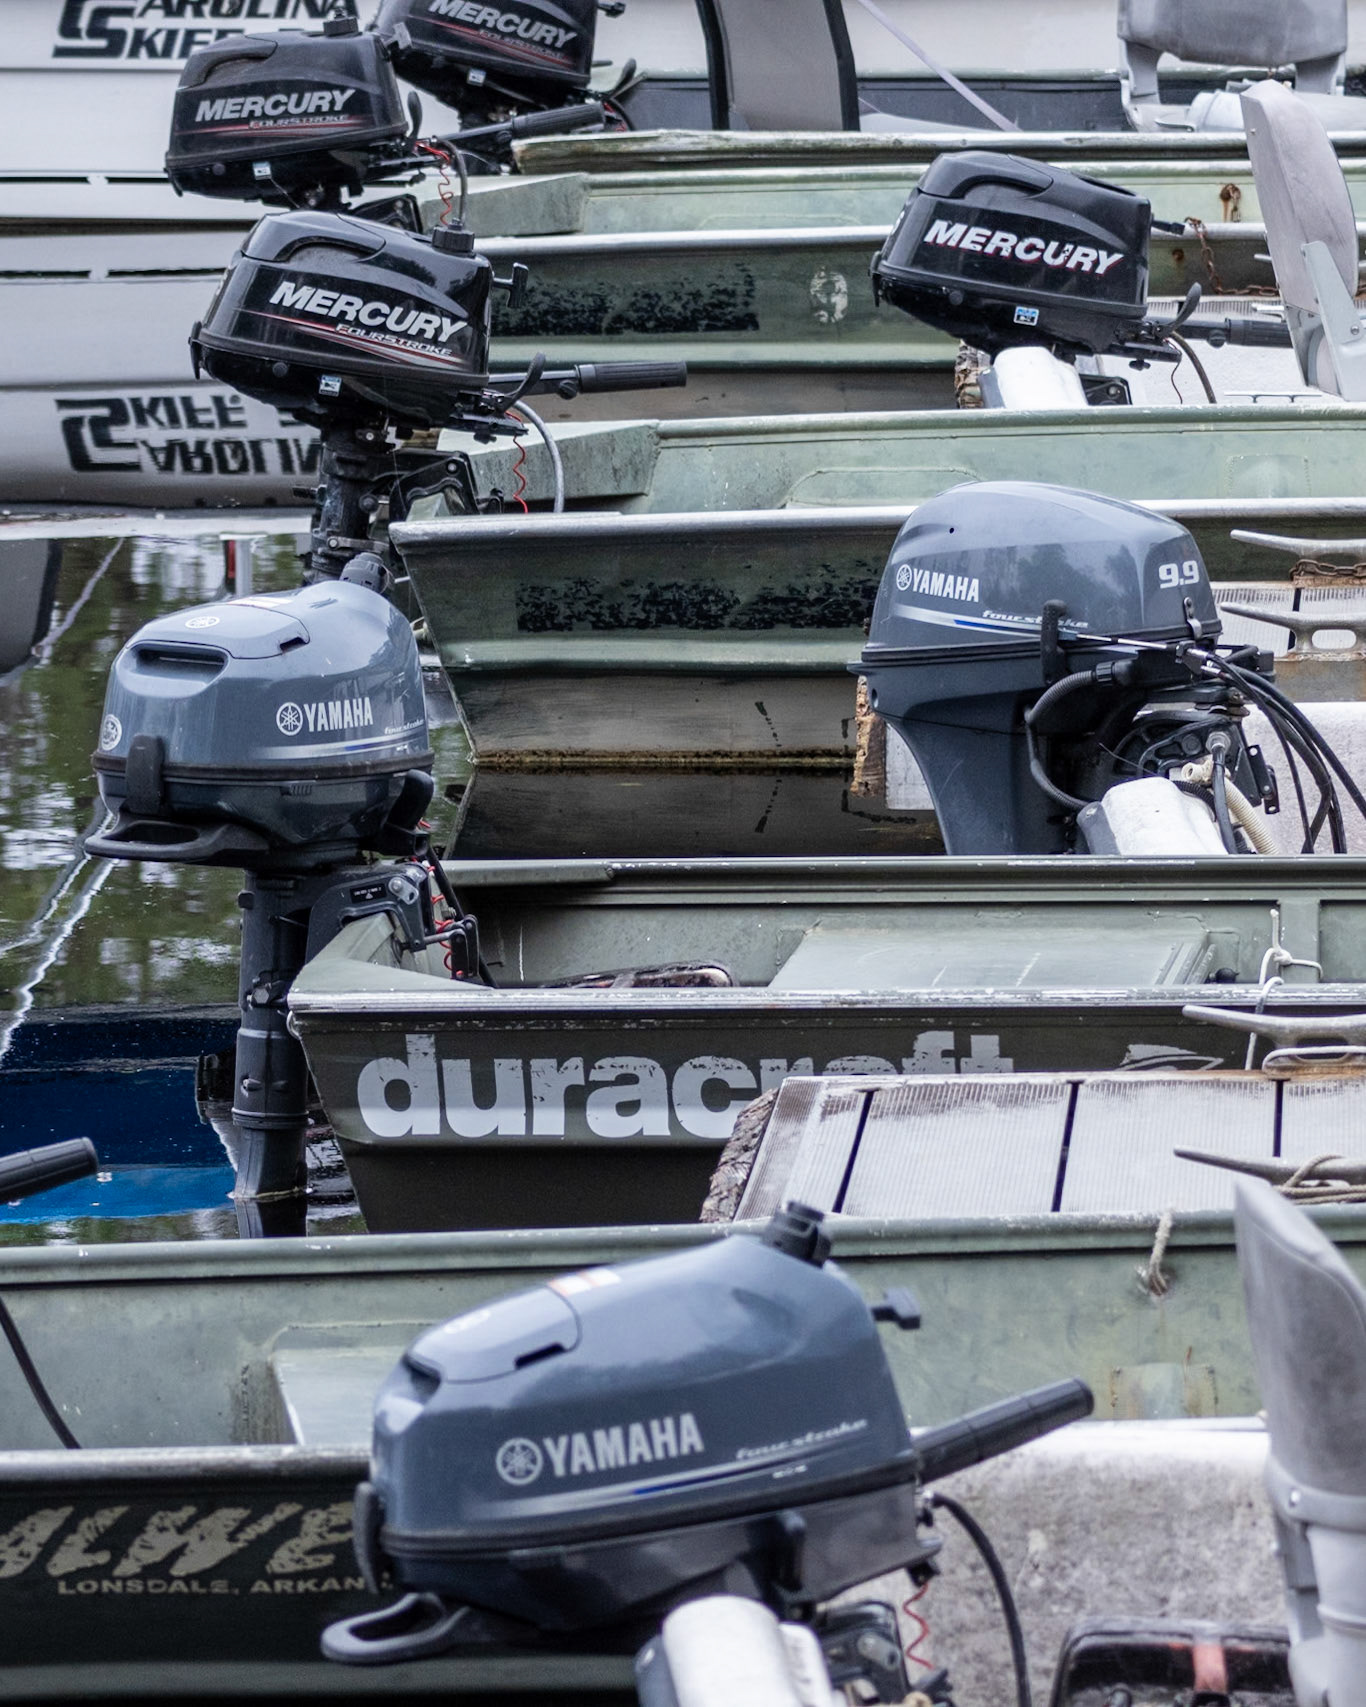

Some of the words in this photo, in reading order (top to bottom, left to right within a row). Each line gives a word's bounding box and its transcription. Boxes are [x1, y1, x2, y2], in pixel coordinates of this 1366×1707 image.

[428, 0, 577, 48] MERCURY
[195, 89, 356, 122] MERCURY
[924, 219, 1124, 276] MERCURY
[269, 281, 468, 342] MERCURY
[334, 323, 453, 355] FOURSTROKE
[912, 568, 979, 603] YAMAHA
[1158, 560, 1200, 589] 9.9
[303, 696, 374, 733] YAMAHA
[357, 1031, 1013, 1138] durac
[542, 1412, 705, 1478] YAMAHA
